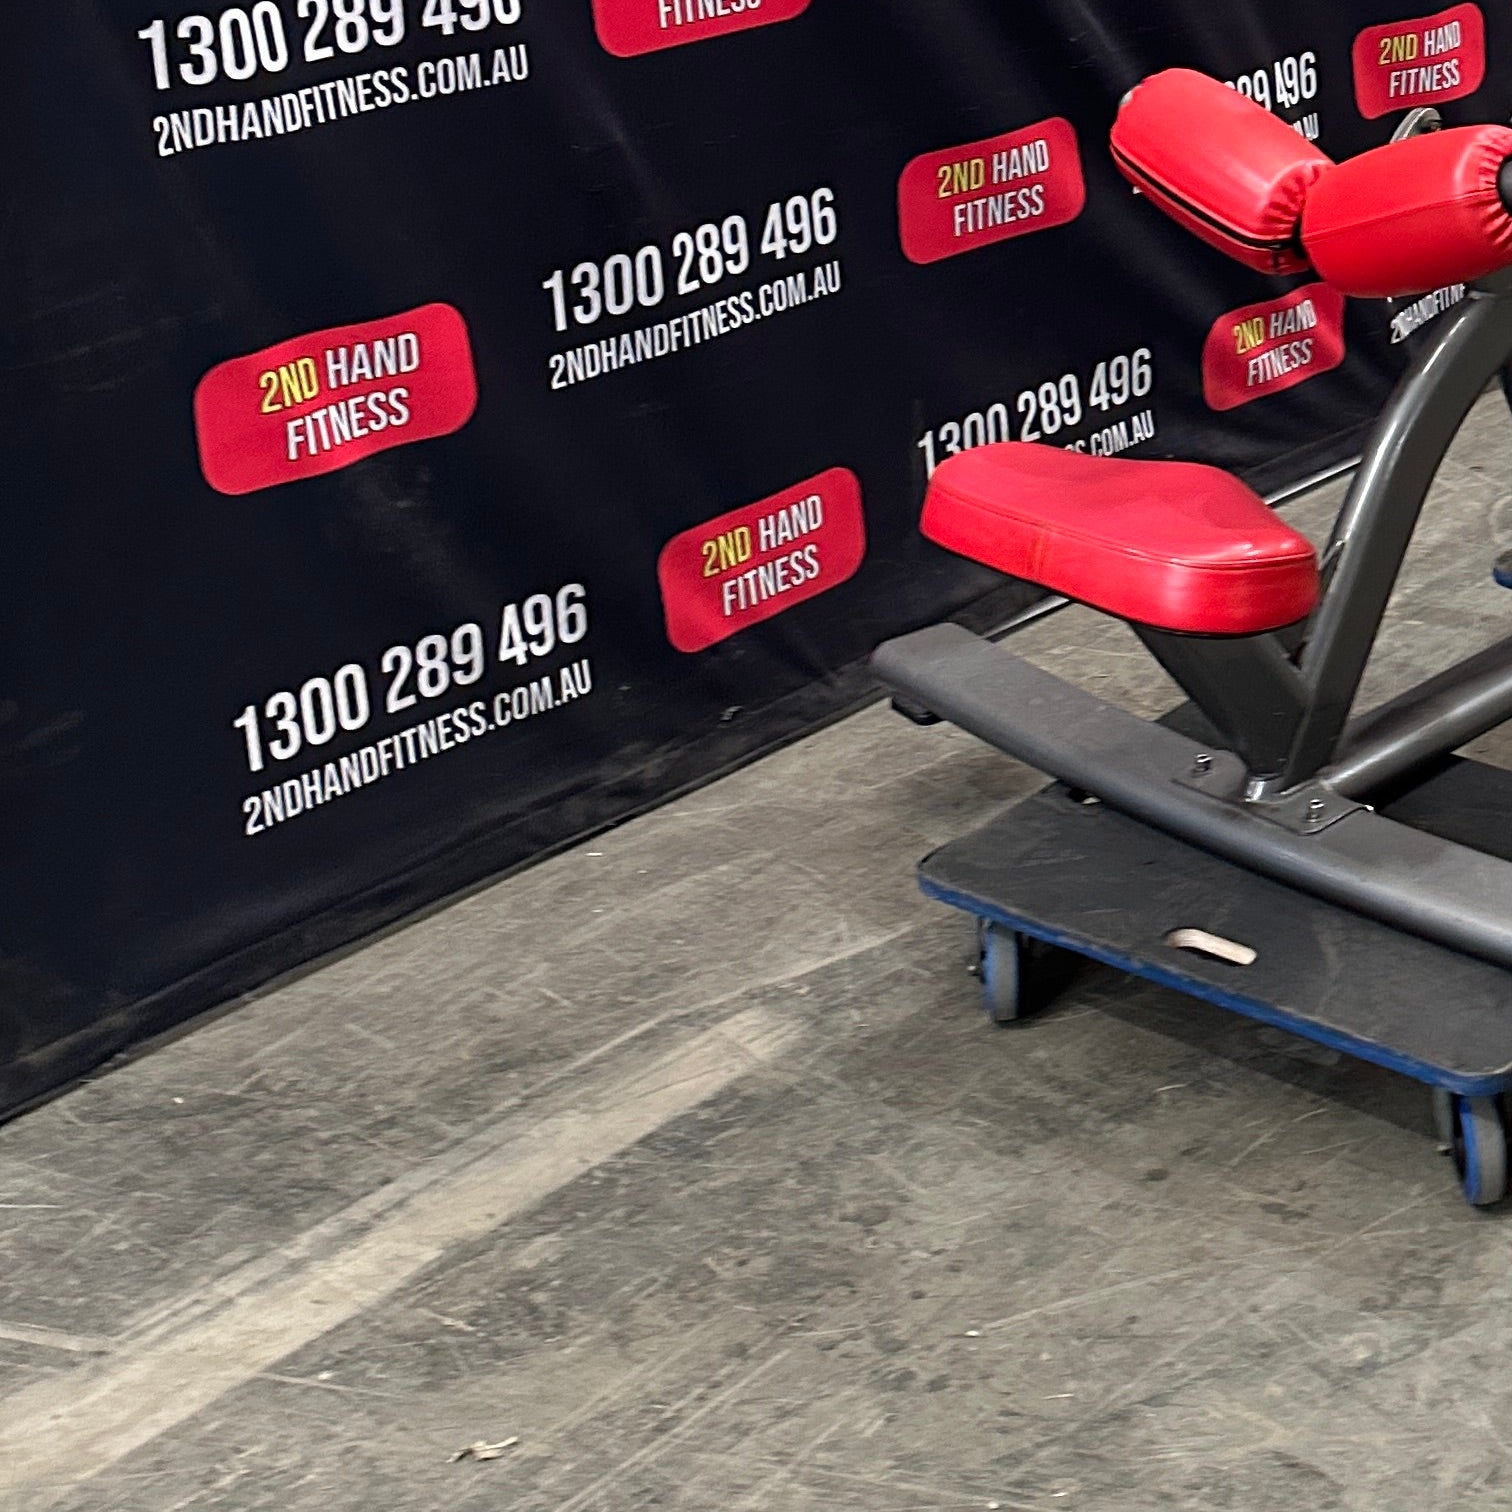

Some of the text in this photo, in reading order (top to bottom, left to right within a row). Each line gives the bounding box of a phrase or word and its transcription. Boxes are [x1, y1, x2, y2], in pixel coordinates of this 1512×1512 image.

[137, 0, 289, 91] 1300
[1274, 51, 1317, 109] 496
[1379, 19, 1461, 67] 2ND HAND
[1388, 58, 1460, 98] FITNESS
[152, 44, 530, 157] 2NDHANDFITNESS.COM.AU
[937, 138, 1050, 200] 2ND HAND
[953, 185, 1045, 238] FITNESS
[541, 186, 838, 333] 1300 289 496
[548, 260, 842, 391] 2NDHANDFITNESS.COM.AU
[1232, 290, 1318, 356] 2ND HAND
[1247, 337, 1313, 388] FITNESS
[259, 331, 420, 414] 2ND HAND
[1017, 373, 1082, 443] 289
[1089, 347, 1152, 411] 496
[285, 388, 410, 462] FITNESS
[701, 494, 824, 578] 2ND HAND
[721, 543, 820, 618] FITNESS
[233, 583, 589, 773] 1300 289 496
[243, 659, 593, 838] 2NDHANDFITNESS.COM.AU
